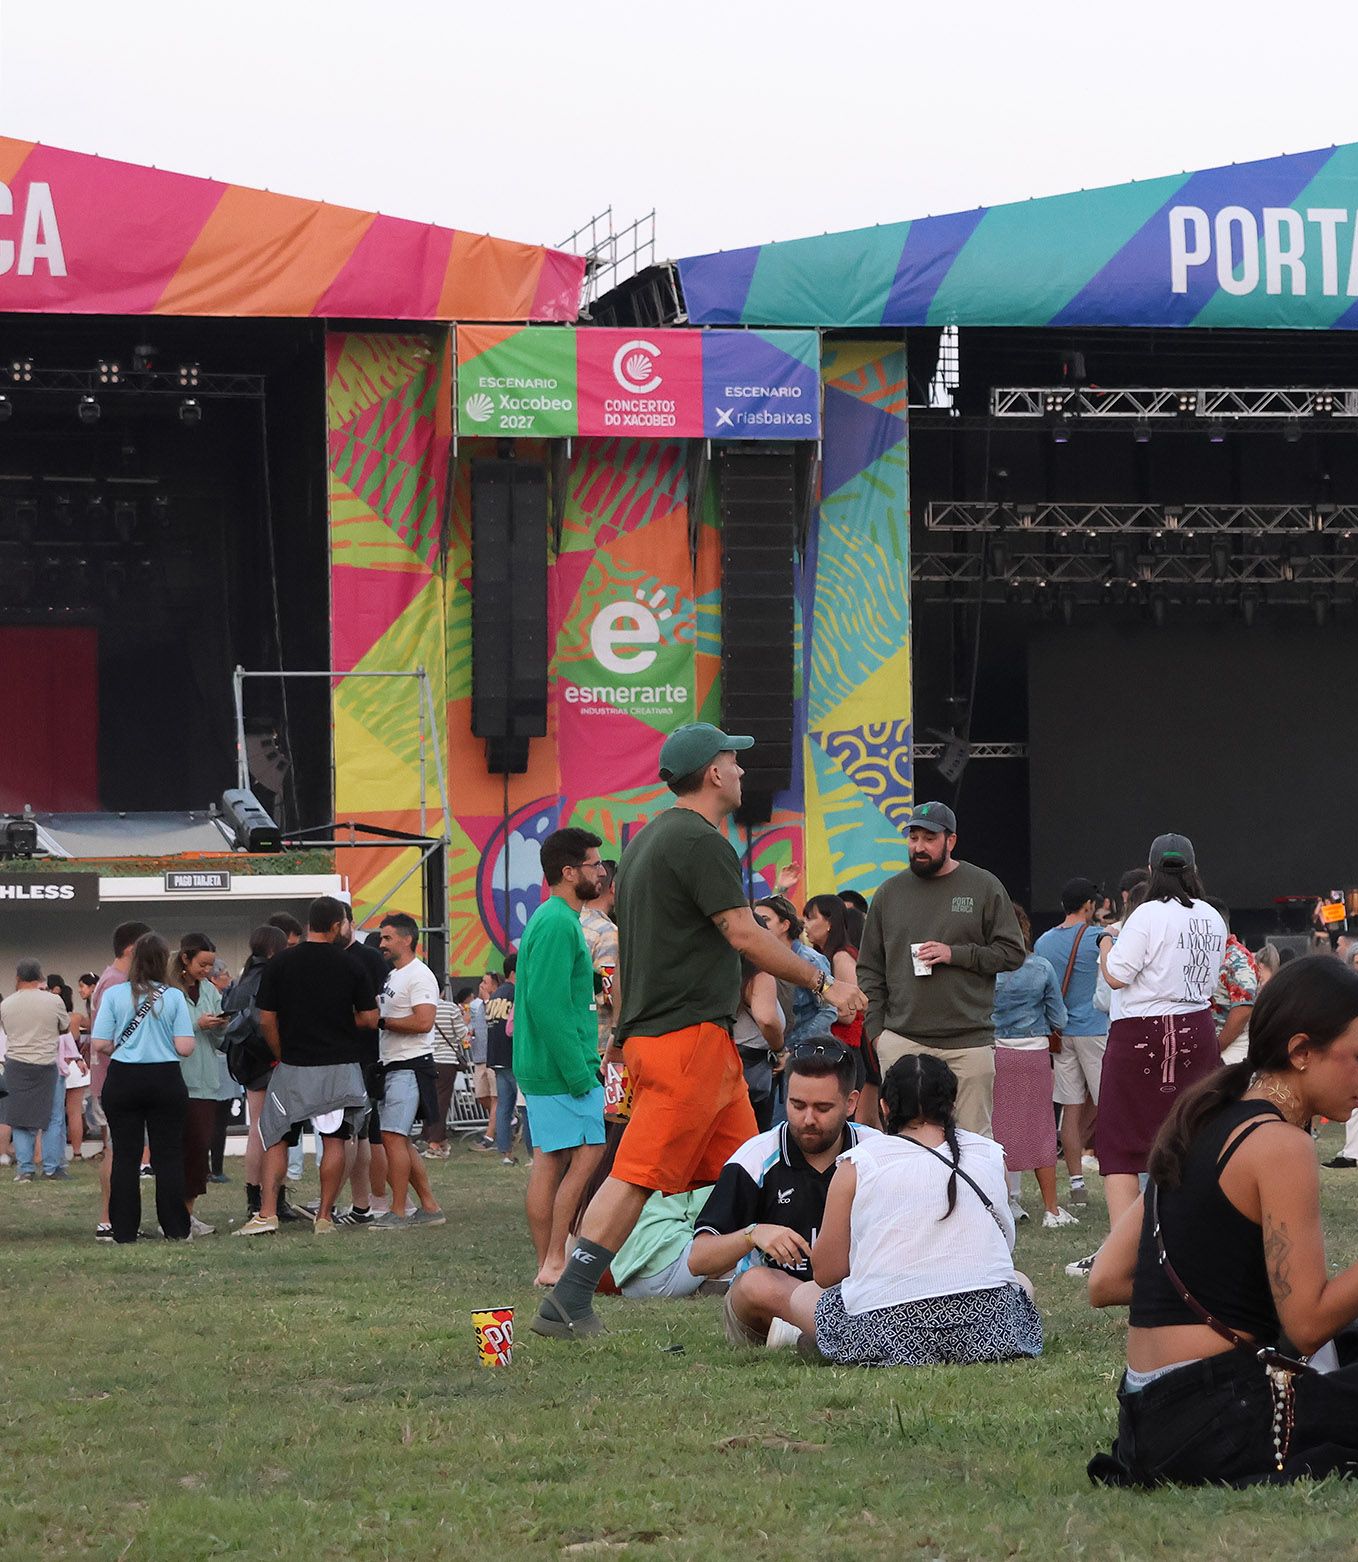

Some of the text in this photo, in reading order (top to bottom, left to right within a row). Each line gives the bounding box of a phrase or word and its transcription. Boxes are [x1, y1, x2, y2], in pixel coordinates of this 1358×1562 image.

[479, 377, 558, 389] ESCENARIO
[725, 387, 802, 397] ESCENARIO
[499, 395, 573, 411] Xacobeo
[605, 400, 676, 412] CONCERTOS
[501, 415, 535, 429] 2027
[605, 414, 676, 427] DO XACOBEO
[737, 410, 812, 425] riasbaixas
[565, 684, 688, 703] esmerarte
[1189, 918, 1213, 935] QUE
[1176, 932, 1185, 949] A
